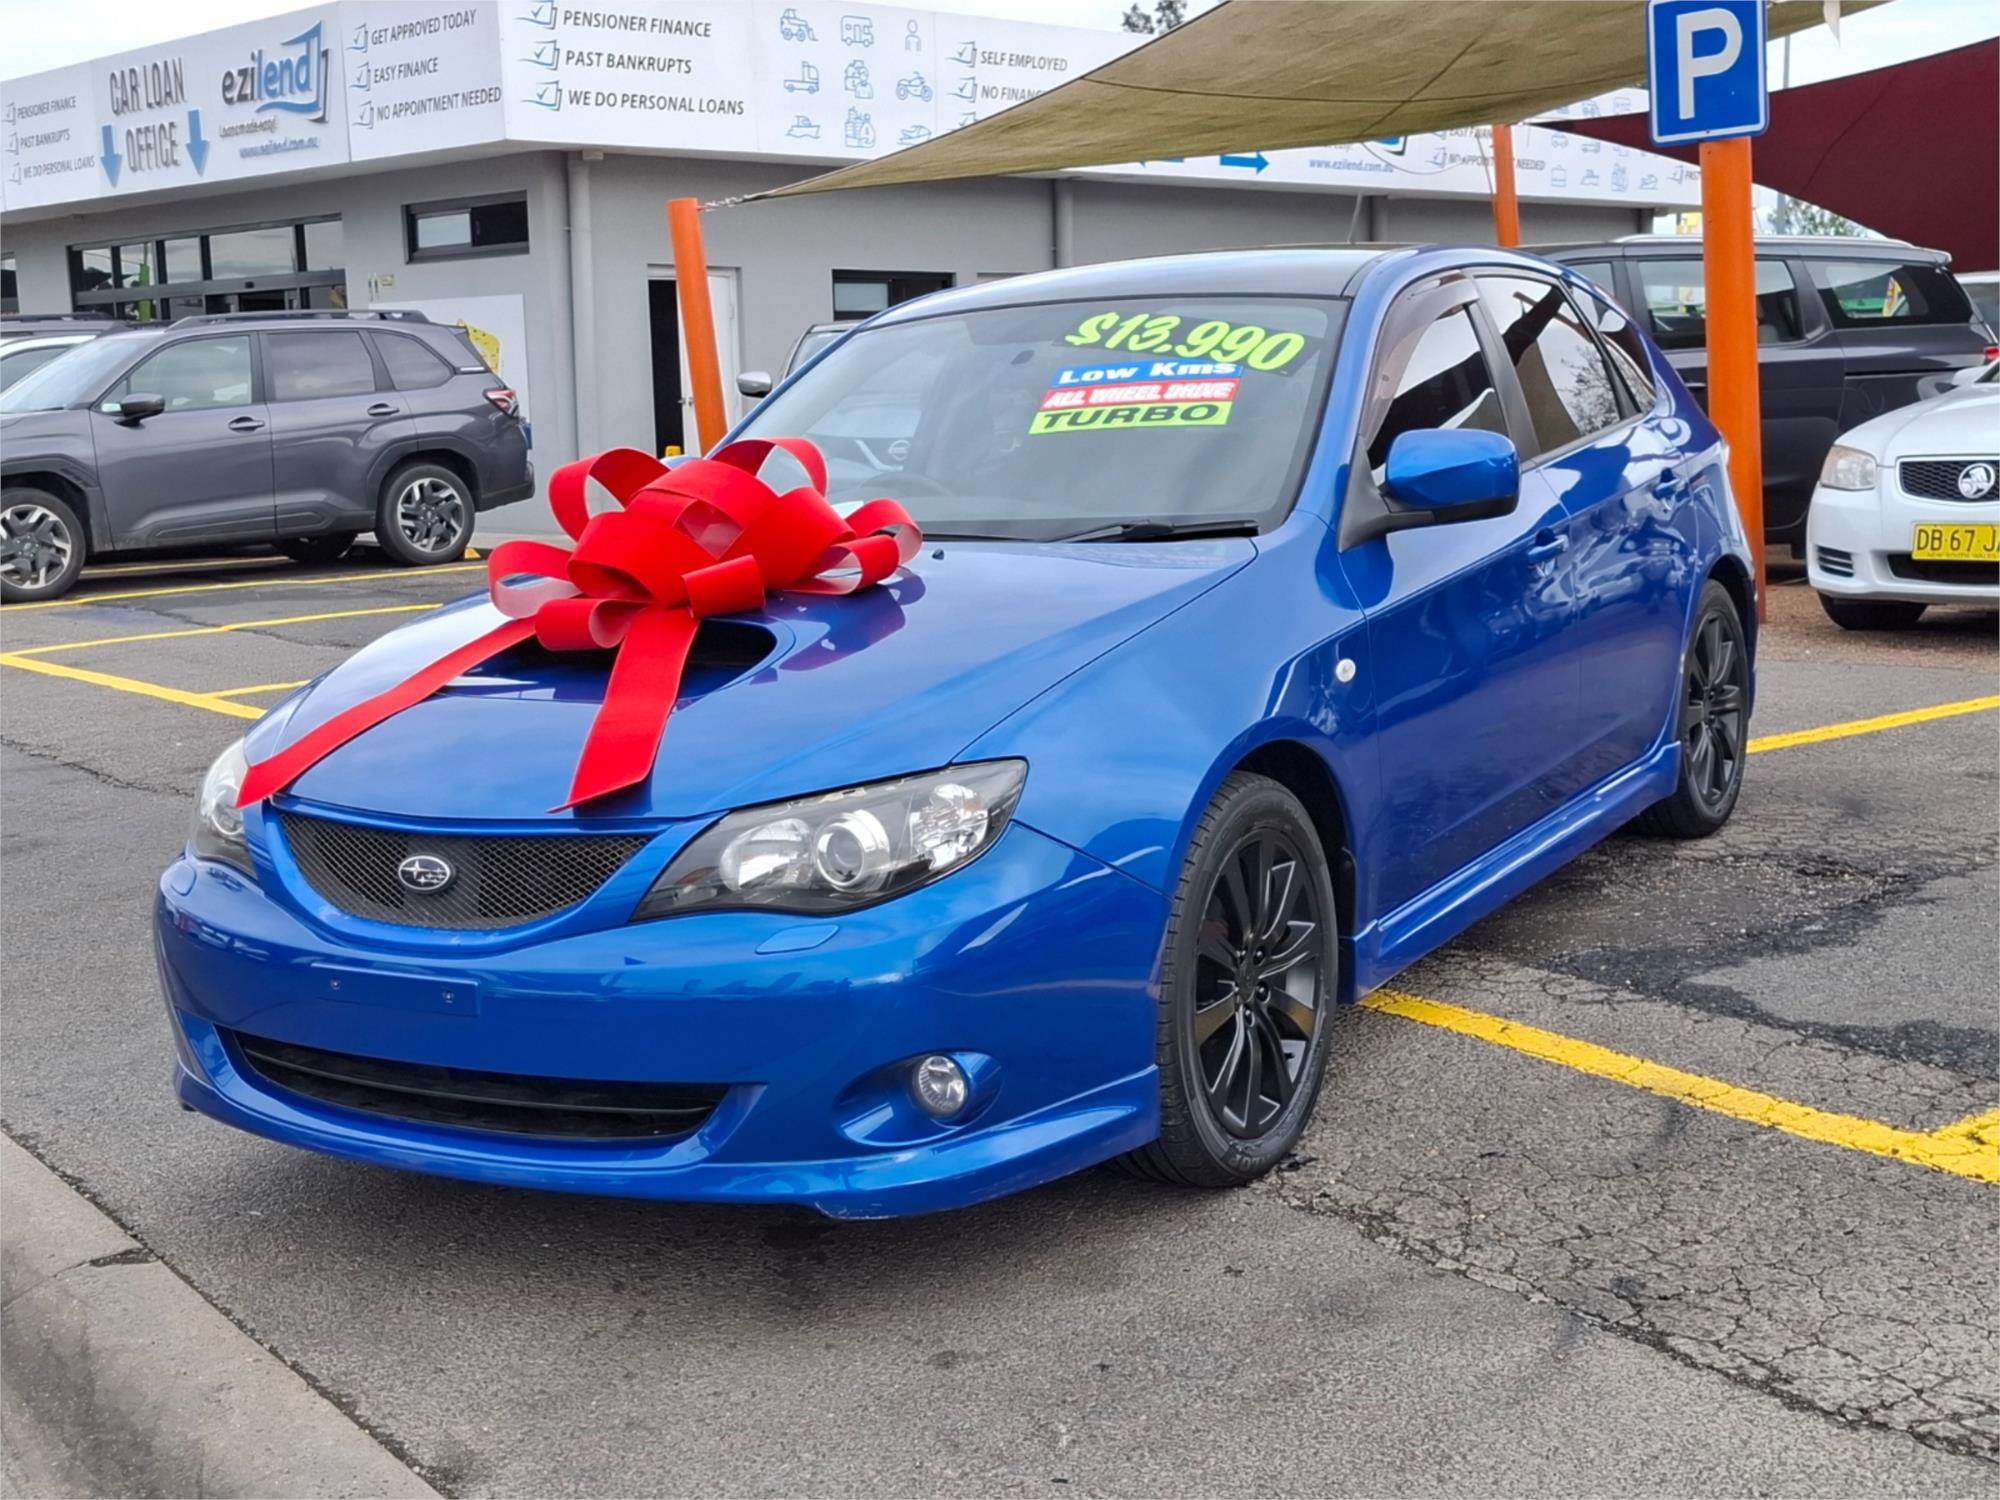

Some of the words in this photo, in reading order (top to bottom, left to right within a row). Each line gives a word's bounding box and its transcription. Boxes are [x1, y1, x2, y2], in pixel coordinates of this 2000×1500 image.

[371, 28, 389, 45] GET
[390, 17, 441, 41] APPROVED
[442, 8, 477, 31] TODAY
[563, 10, 647, 32] PENSIONER
[650, 18, 712, 38] FINANCE
[222, 40, 312, 106] ezilend
[374, 64, 396, 84] EASY
[398, 57, 439, 79] FINANCE
[565, 50, 603, 68] PAST
[606, 53, 692, 74] BANKRUPTS
[981, 51, 1007, 65] SELF
[1008, 53, 1068, 71] EMPLOYED
[1675, 8, 1743, 120] P
[109, 67, 142, 116] CAR
[143, 57, 188, 109] LOAN
[981, 85, 999, 99] NO
[1001, 87, 1046, 100] FINAN
[17, 101, 49, 119] PENSIONER
[50, 96, 76, 111] FINANCE
[377, 105, 390, 121] NO
[392, 93, 459, 118] APPOINTMENT
[462, 86, 502, 107] NEEDED
[568, 89, 591, 106] WE
[594, 91, 617, 107] DO
[621, 93, 695, 112] PERSONAL
[698, 98, 744, 115] LOANS
[125, 121, 181, 173] OFFICE
[1149, 362, 1237, 376] Kms
[1043, 390, 1087, 408] ALL
[1088, 385, 1162, 404] WHEEL
[1163, 382, 1237, 401] DRIVE
[1044, 404, 1219, 429] TURBO
[1983, 529, 1999, 552] J
